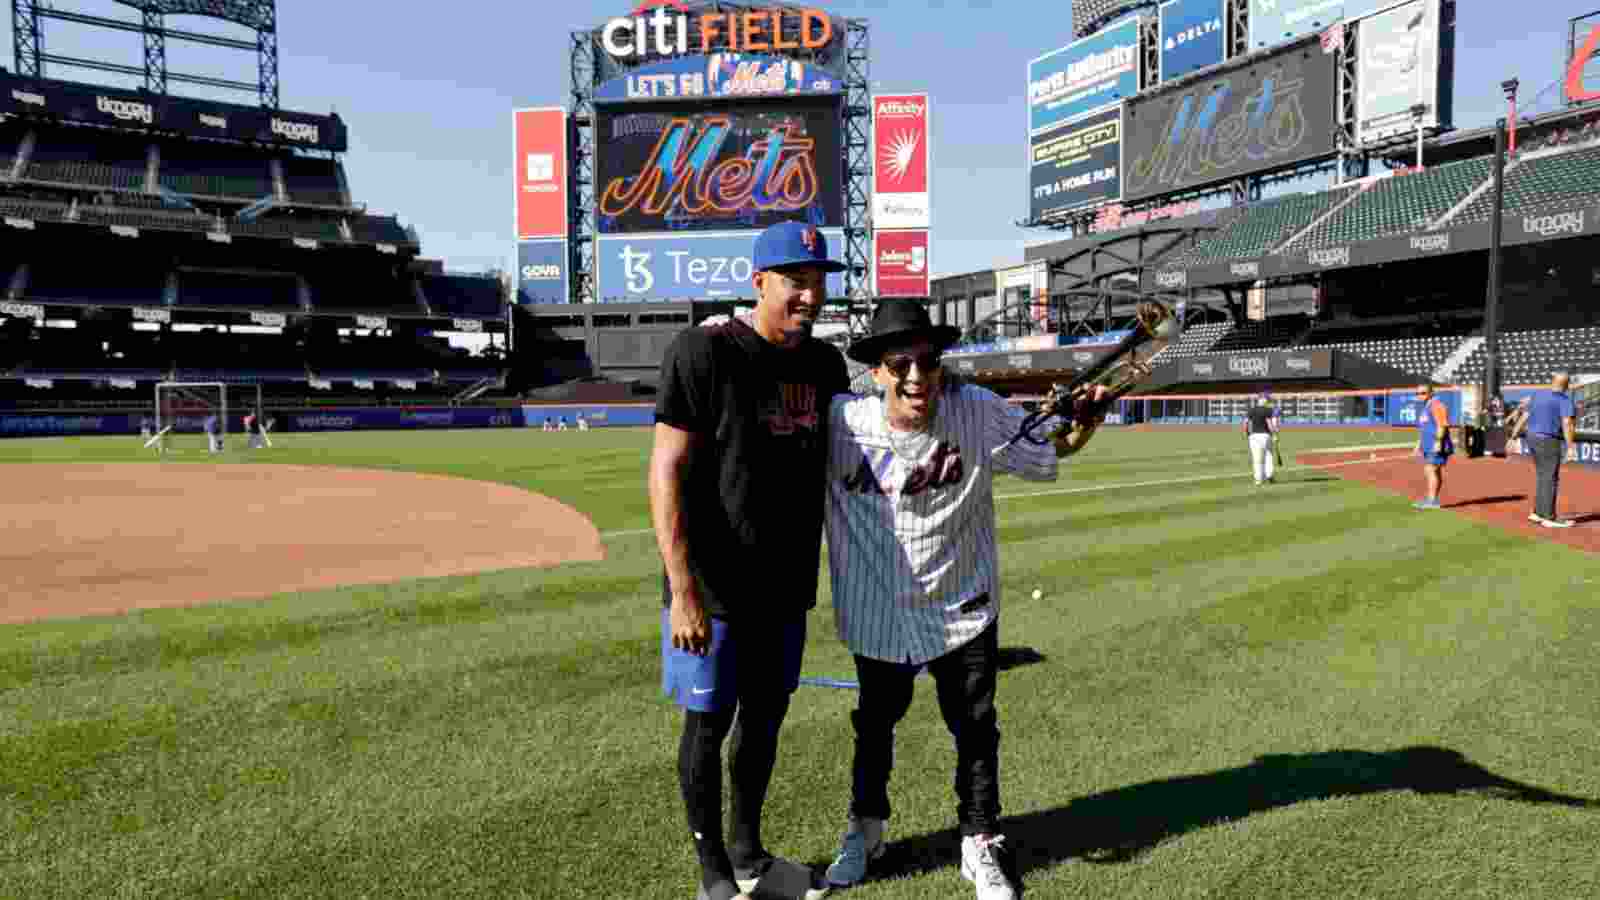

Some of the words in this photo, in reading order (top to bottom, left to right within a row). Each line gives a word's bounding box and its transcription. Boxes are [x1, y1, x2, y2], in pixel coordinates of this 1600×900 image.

[601, 8, 688, 57] citi
[702, 10, 833, 52] FIELD
[1176, 18, 1221, 43] DELTA
[1083, 127, 1114, 144] CITY
[600, 114, 817, 217] Mets
[664, 249, 753, 284] Tezo
